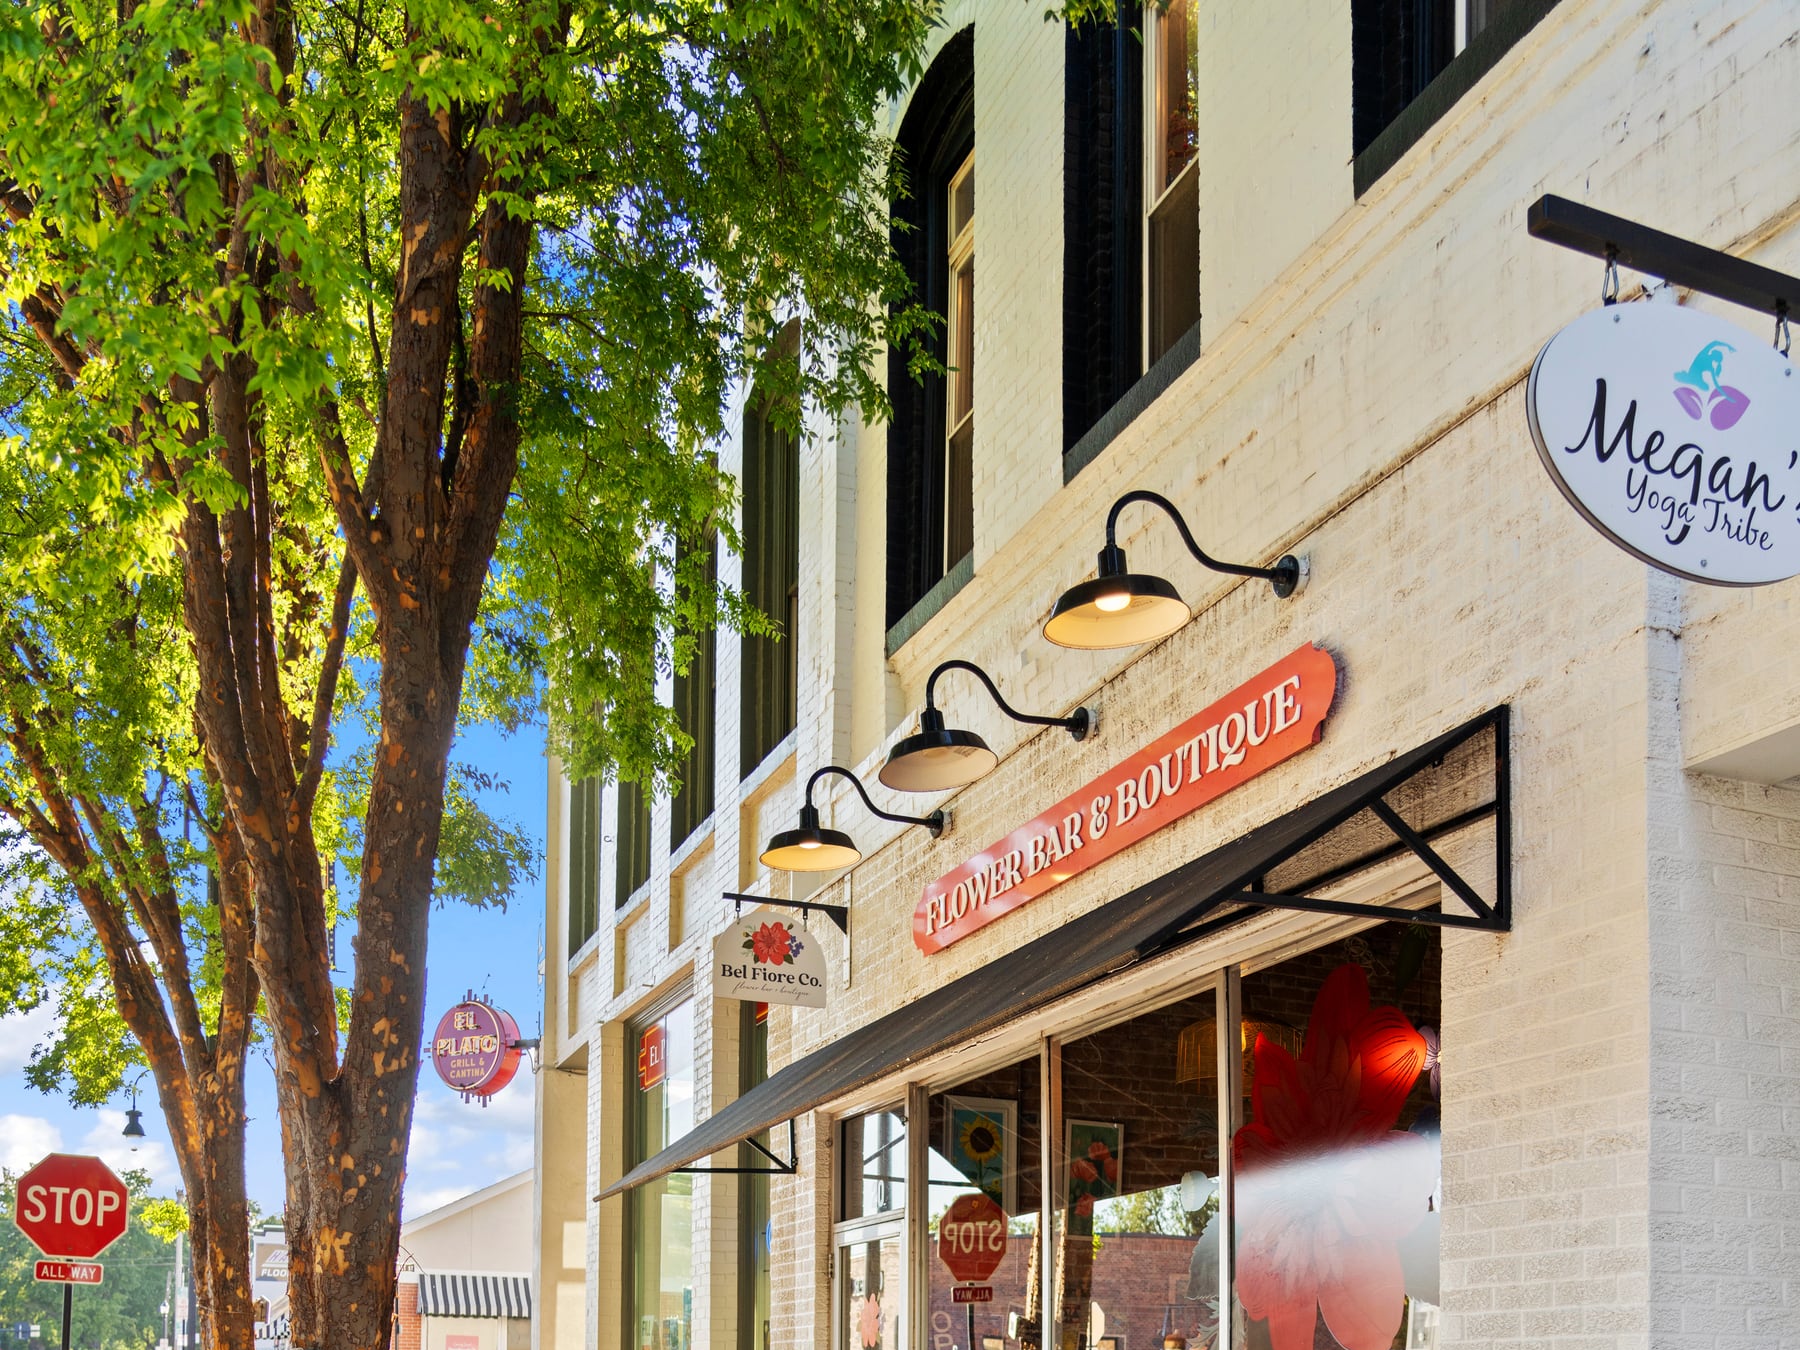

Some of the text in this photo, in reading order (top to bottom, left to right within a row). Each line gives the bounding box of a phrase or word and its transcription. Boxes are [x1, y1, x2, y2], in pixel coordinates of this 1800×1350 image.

[1565, 378, 1800, 545] Megan'
[1626, 467, 1774, 551] Yoga Tribe
[925, 674, 1303, 936] FLOWER BAR & BOUTIQUE
[721, 963, 822, 988] Bel Fiore Co.
[454, 1011, 480, 1031] EL
[436, 1034, 498, 1057] PLATO
[649, 1045, 660, 1068] EL
[449, 1068, 485, 1079] CANTINA
[450, 1057, 485, 1068] GRILL &
[23, 1184, 120, 1227] STOP
[41, 1265, 97, 1280] ALL WAY
[261, 1268, 289, 1277] FLOO
